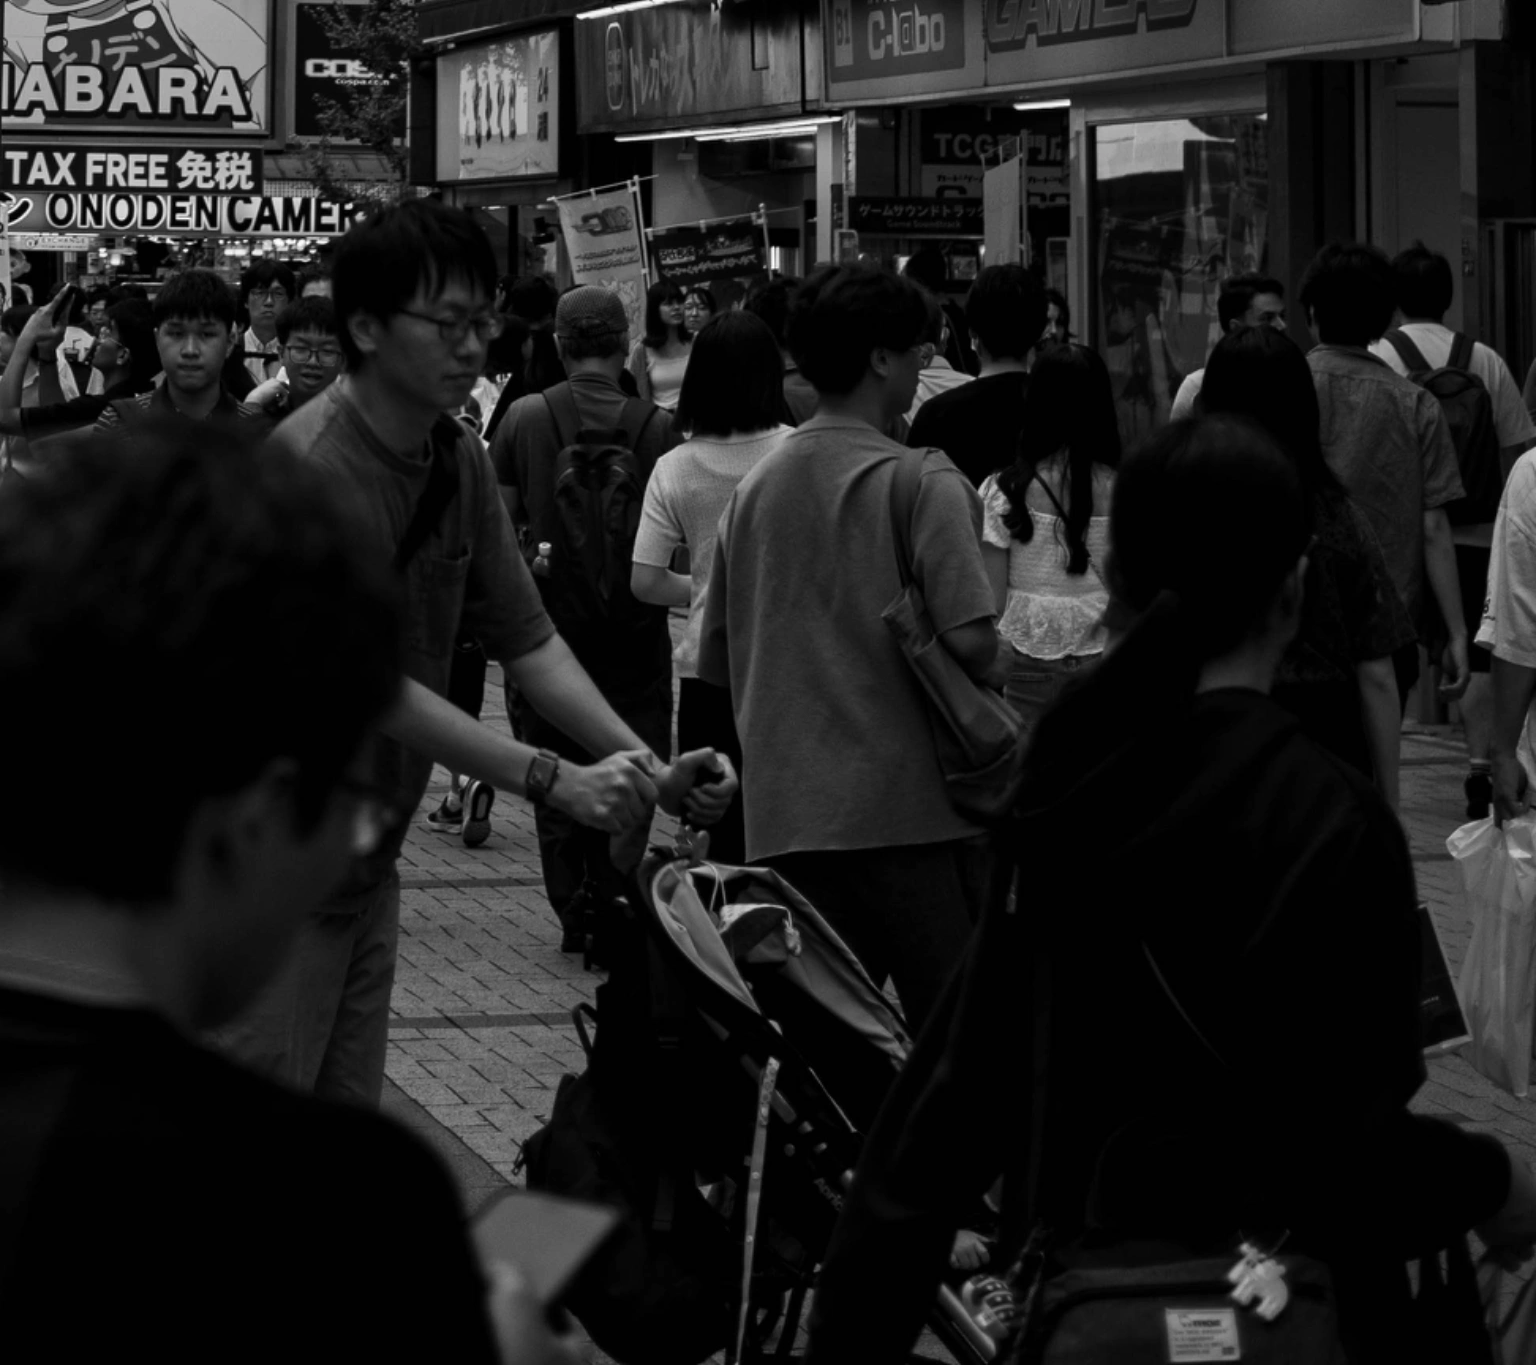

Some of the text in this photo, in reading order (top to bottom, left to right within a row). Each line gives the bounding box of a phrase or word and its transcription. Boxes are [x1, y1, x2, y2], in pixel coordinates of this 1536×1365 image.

[4, 150, 169, 188] TAX FREE
[175, 148, 255, 191] 免税
[47, 192, 220, 229] ONODEN
